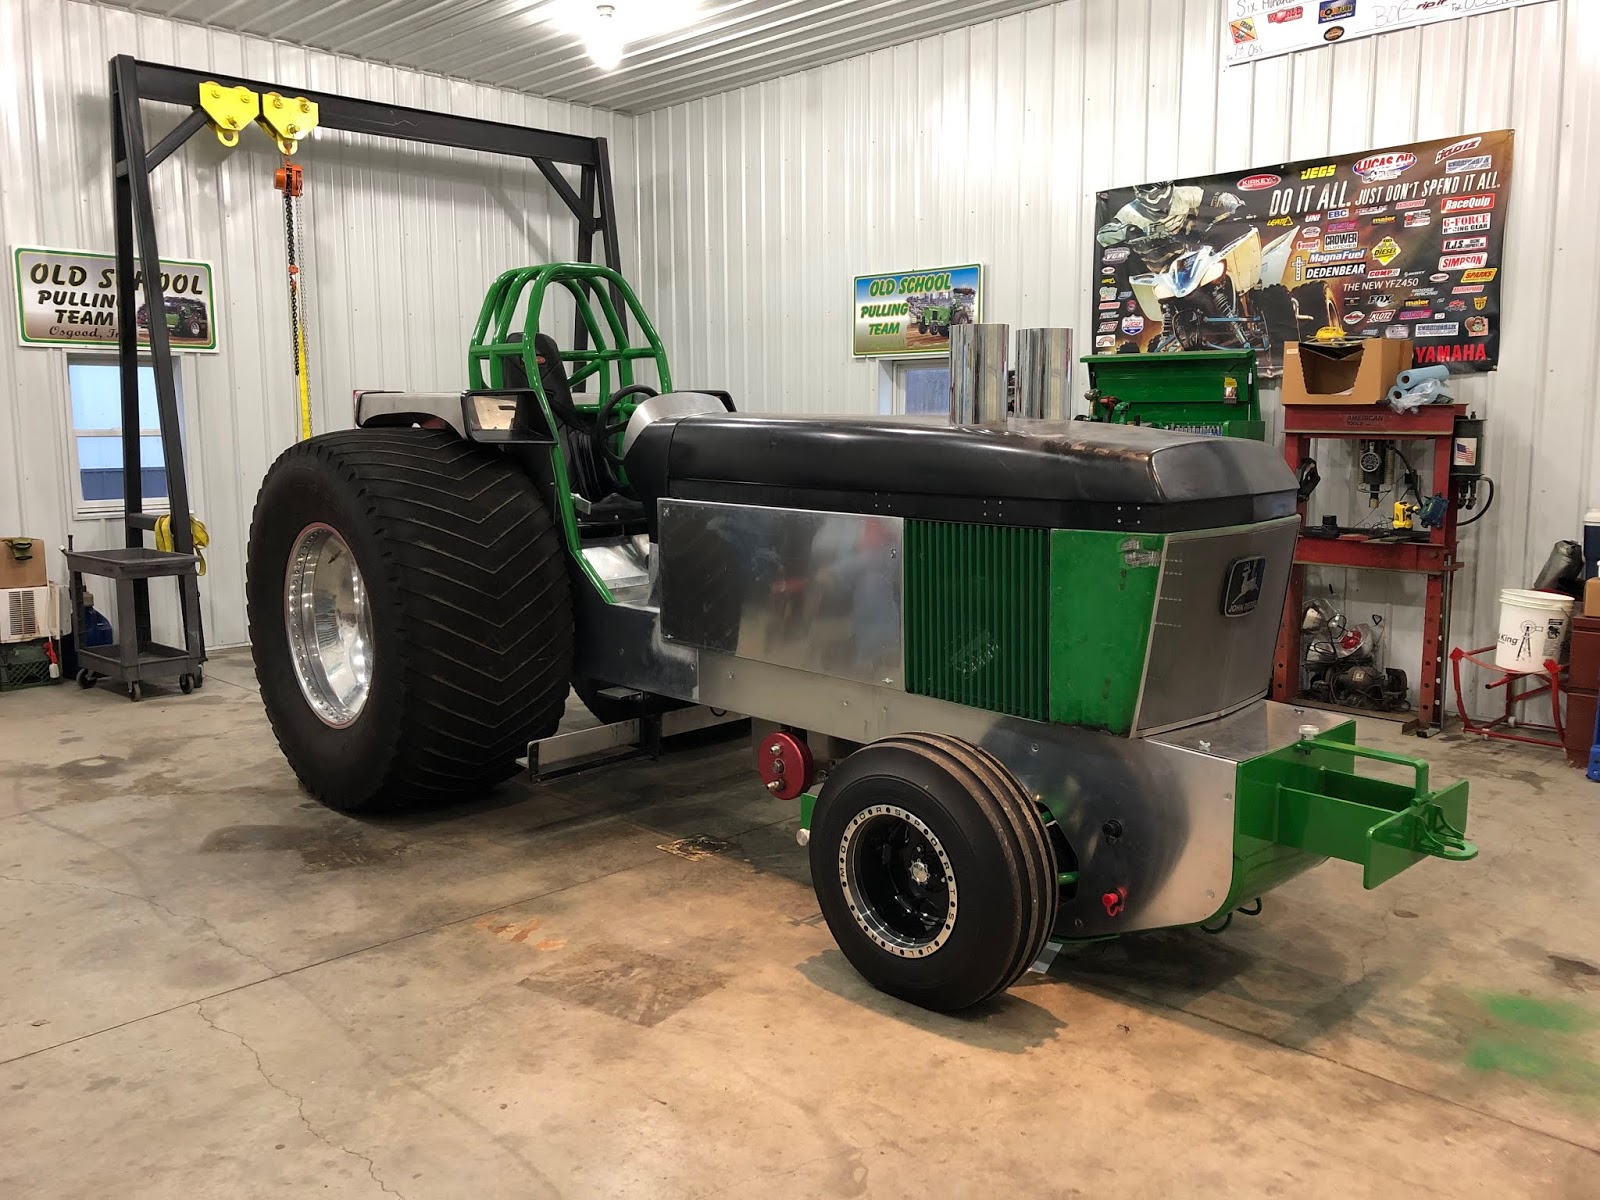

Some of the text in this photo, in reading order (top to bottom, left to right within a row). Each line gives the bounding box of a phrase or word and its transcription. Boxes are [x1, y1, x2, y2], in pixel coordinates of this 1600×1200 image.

[1301, 164, 1337, 180] JEGS
[1269, 171, 1501, 217] DO IT ALL. JUST DON'T SPEND IT ALL.
[1445, 196, 1491, 210] RaceQuip
[1328, 210, 1348, 219] EBC
[1443, 214, 1489, 228] G-FORCE
[1325, 232, 1357, 246] CROWER
[1309, 249, 1365, 264] MagnaFuel
[1374, 248, 1397, 256] DIESEL
[1442, 255, 1483, 268] SIMPSON
[30, 262, 87, 287] OLD
[1306, 264, 1366, 279] DEDENBEAR
[1465, 270, 1493, 279] SPARKS
[869, 273, 951, 297] OLD SCHOOL
[1343, 277, 1419, 292] THE NEW YFZ450
[37, 290, 117, 309] PULLIN
[54, 308, 114, 327] TEAM
[860, 302, 909, 319] PULLING
[1371, 311, 1393, 321] KLOTZ
[49, 325, 103, 340] Osgood,
[868, 322, 900, 336] TEAM
[1415, 343, 1487, 363] YAMAHA
[1501, 633, 1519, 646] King
